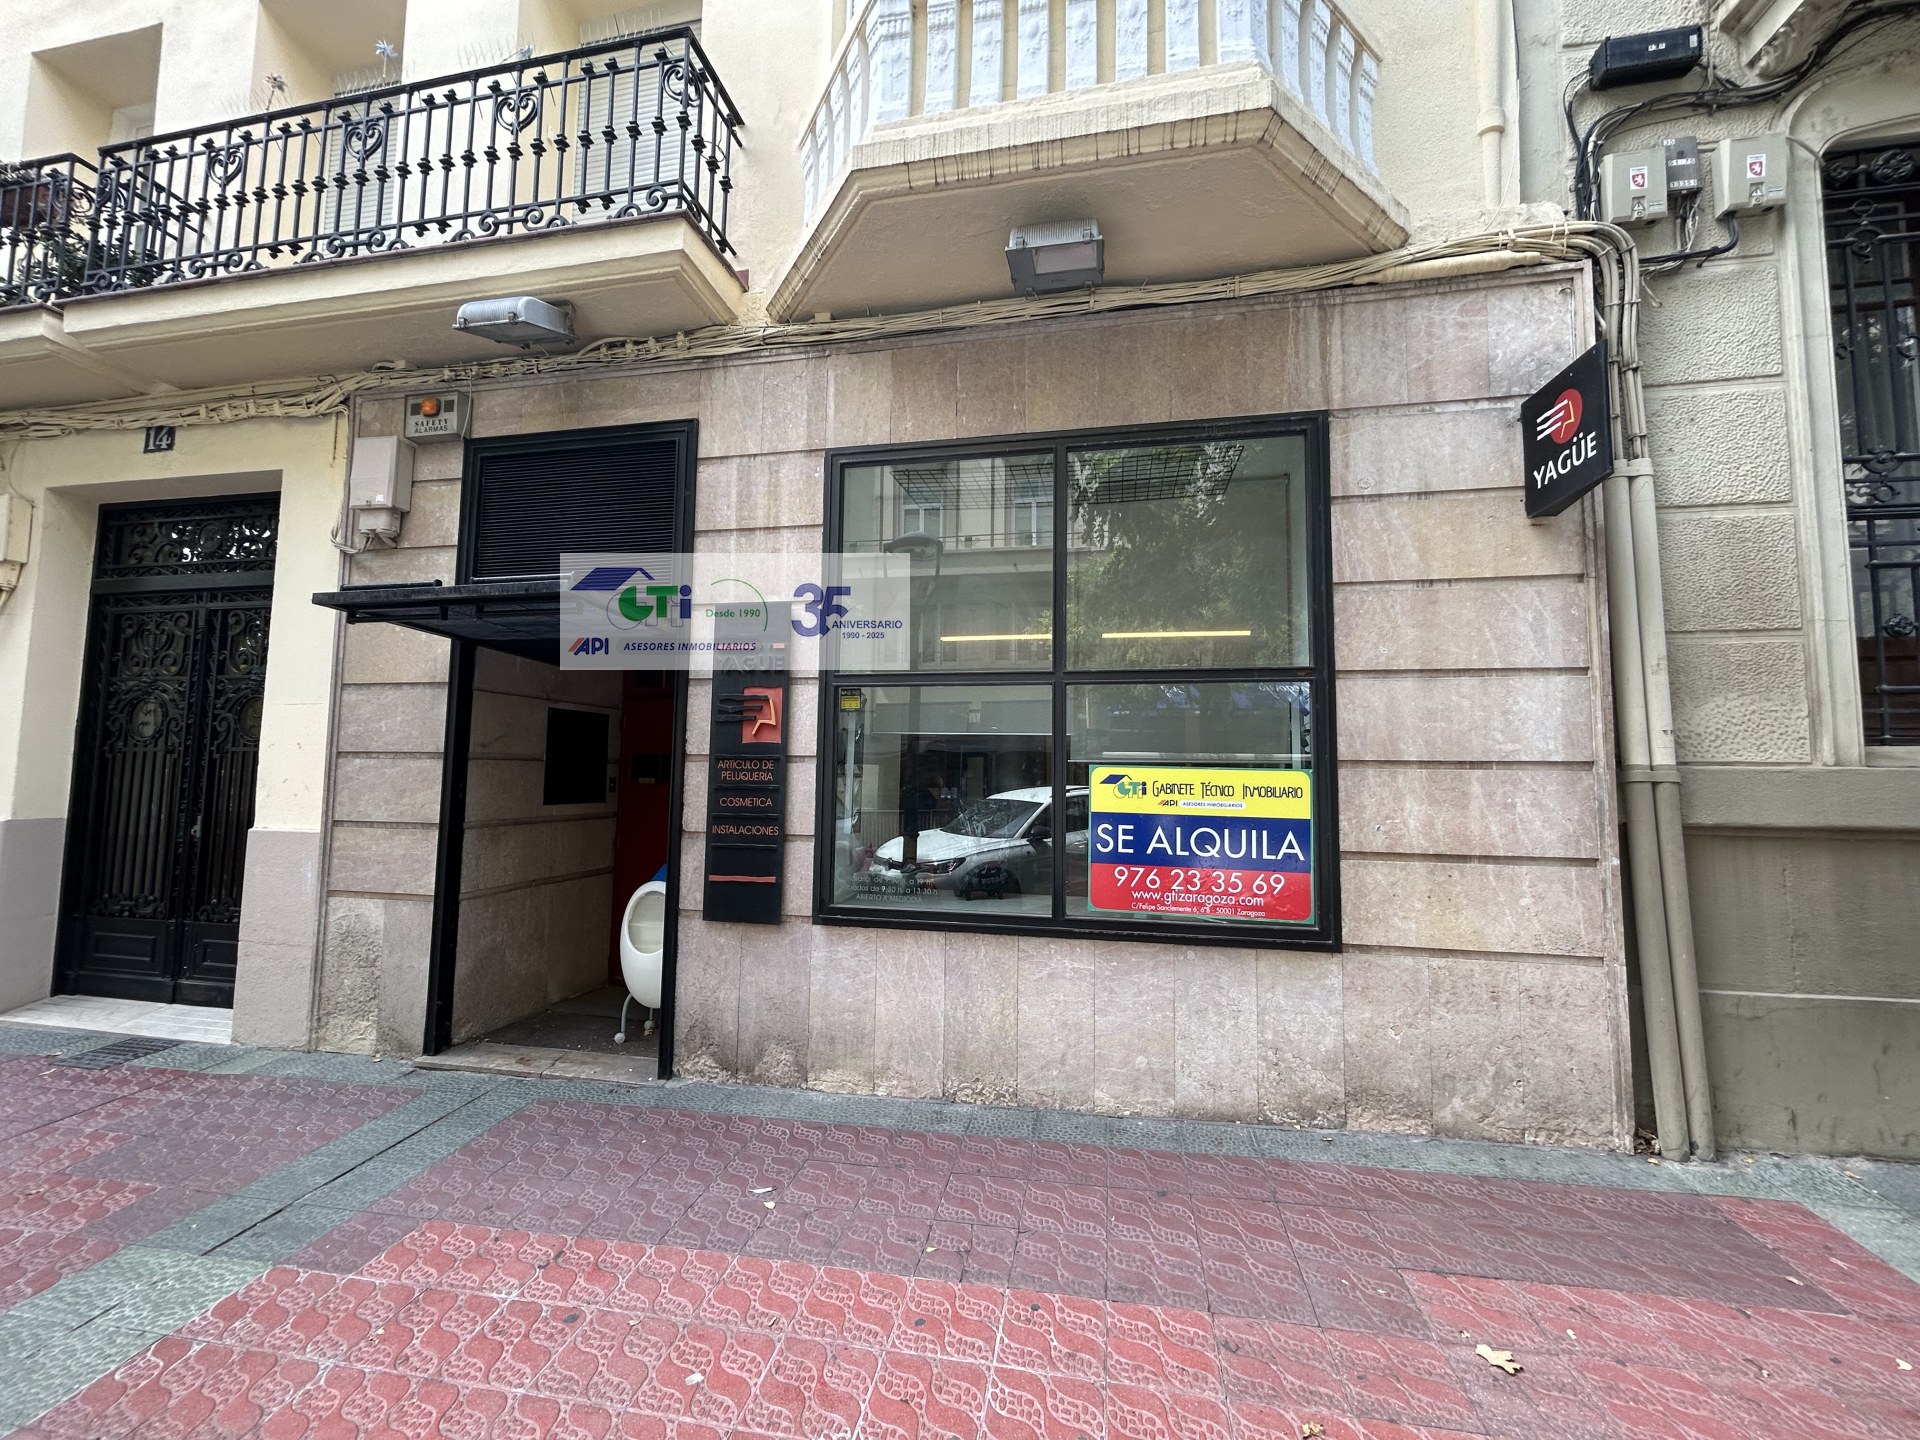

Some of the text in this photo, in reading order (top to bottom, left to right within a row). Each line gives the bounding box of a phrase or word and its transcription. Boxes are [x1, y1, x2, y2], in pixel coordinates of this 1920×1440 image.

[414, 418, 449, 428] SAFETY
[414, 425, 449, 434] ALARMAS
[147, 426, 172, 450] 14
[1532, 431, 1597, 490] YAGÜE
[762, 760, 774, 770] DE
[721, 770, 774, 782] PELUQUERÍA
[1152, 780, 1195, 797] GABINETE
[1242, 783, 1304, 800] INMOBILIARIO
[719, 796, 773, 807] COSMÉTICA
[712, 824, 780, 836] INSTALACIONES
[1096, 823, 1305, 862] SE ALQUILA
[1114, 866, 1286, 895] 976 23 35 69
[1131, 890, 1264, 907] www.gtizaragoza.com
[1157, 904, 1192, 912] Sanclemente
[1237, 908, 1266, 918] Zaragoza
